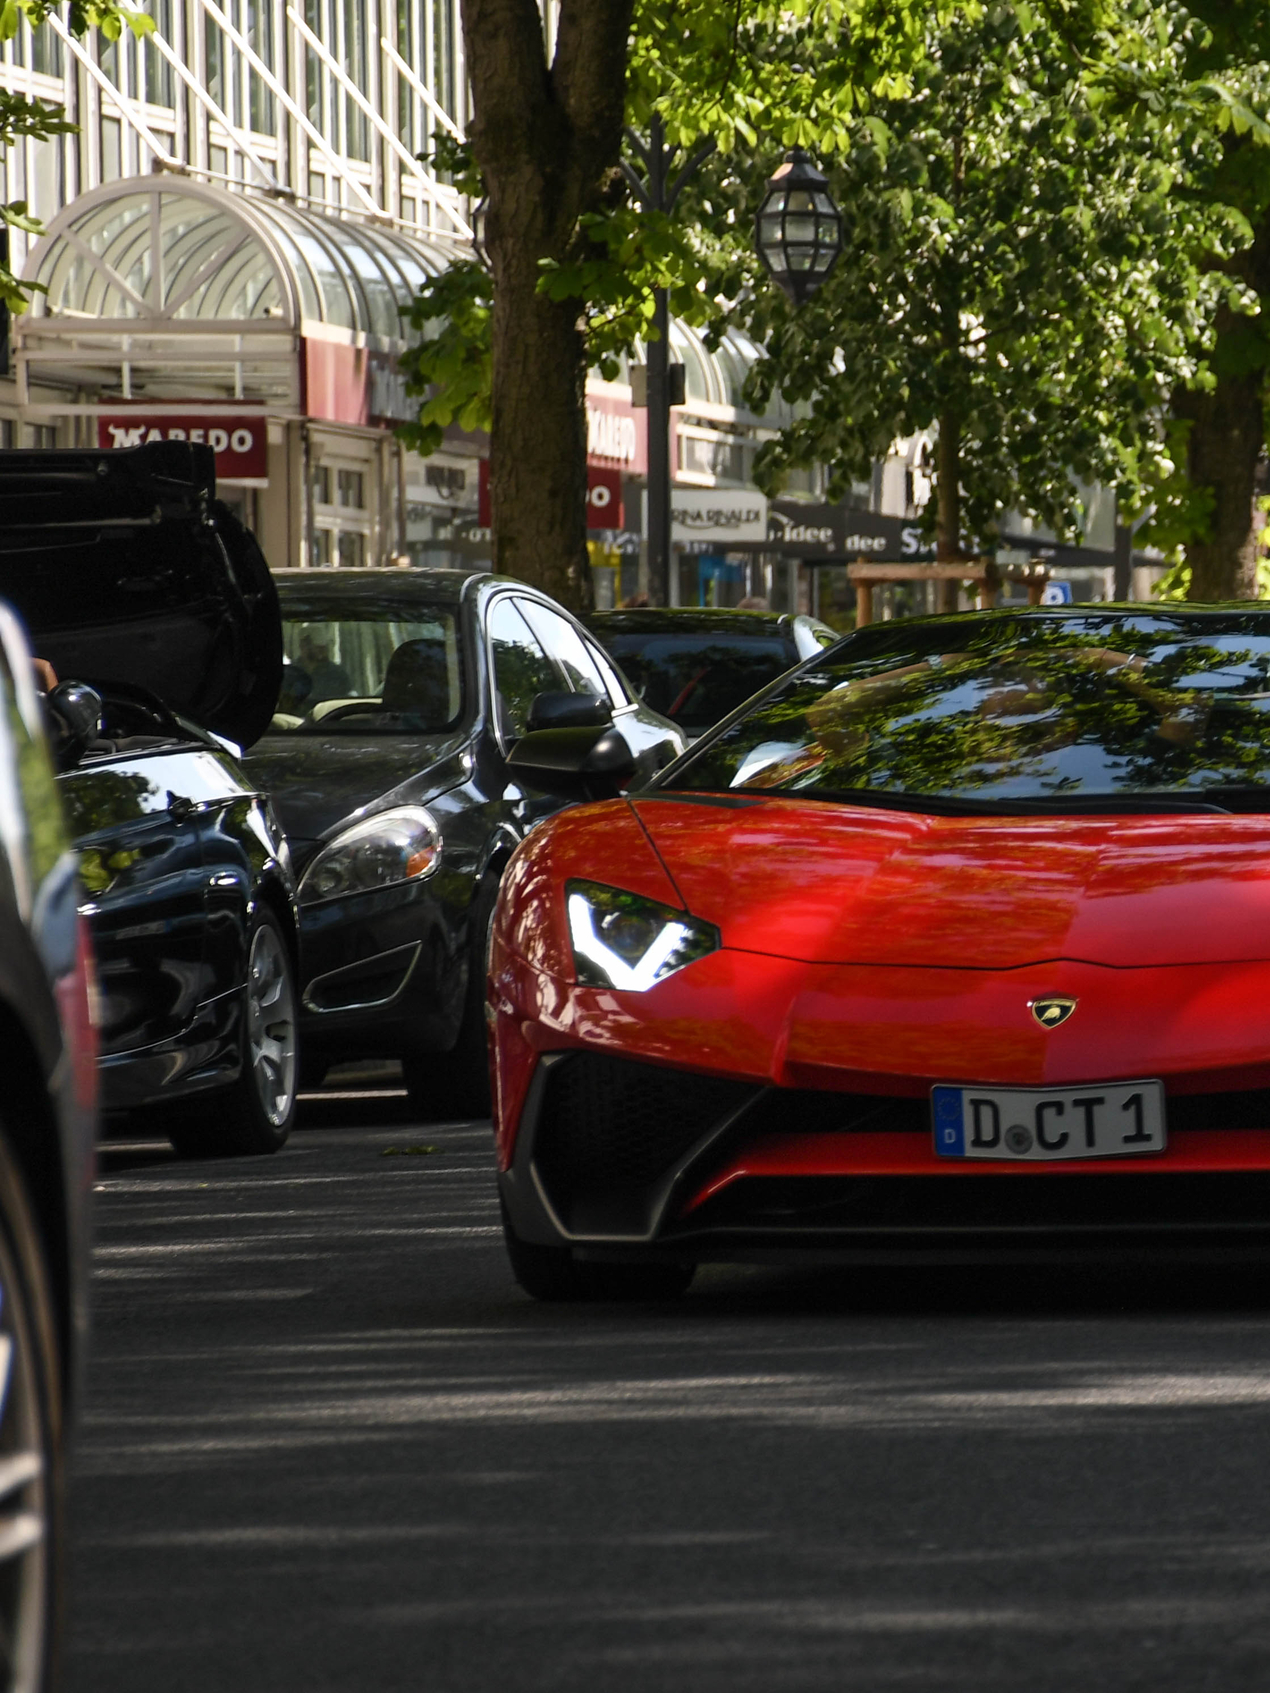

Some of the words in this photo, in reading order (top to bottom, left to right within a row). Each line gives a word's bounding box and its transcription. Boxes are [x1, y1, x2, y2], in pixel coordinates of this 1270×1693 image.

[944, 1129, 956, 1144] D
[969, 1098, 1000, 1148] D
[1035, 1097, 1105, 1151] CT
[1121, 1093, 1153, 1144] 1
